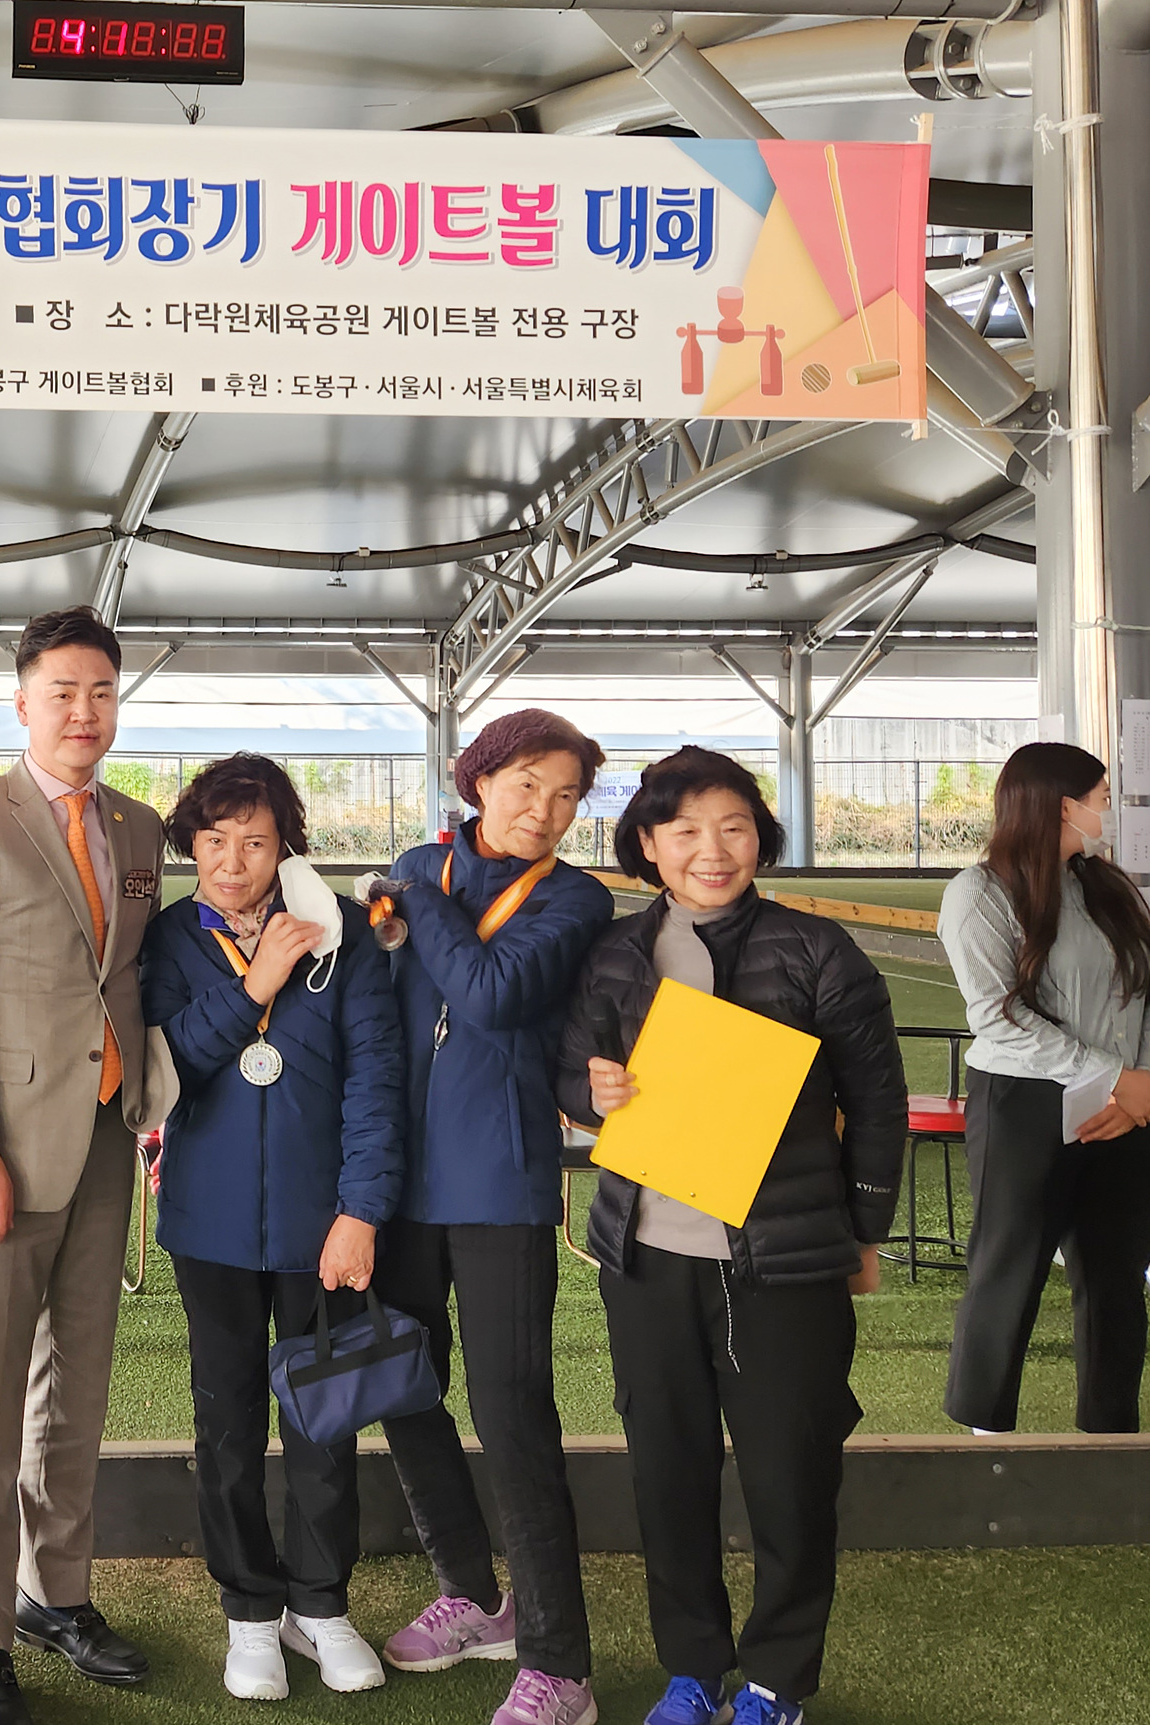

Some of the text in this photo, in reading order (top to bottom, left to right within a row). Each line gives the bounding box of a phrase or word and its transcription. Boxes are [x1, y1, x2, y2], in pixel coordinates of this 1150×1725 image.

[290, 180, 559, 268] 게이트볼
[584, 185, 717, 272] 대회
[165, 301, 370, 336] 다락원체육공원
[382, 305, 500, 338] 게이트볼
[511, 307, 569, 339] 전용
[580, 308, 639, 340] 구장
[38, 370, 173, 397] 게이트볼협회
